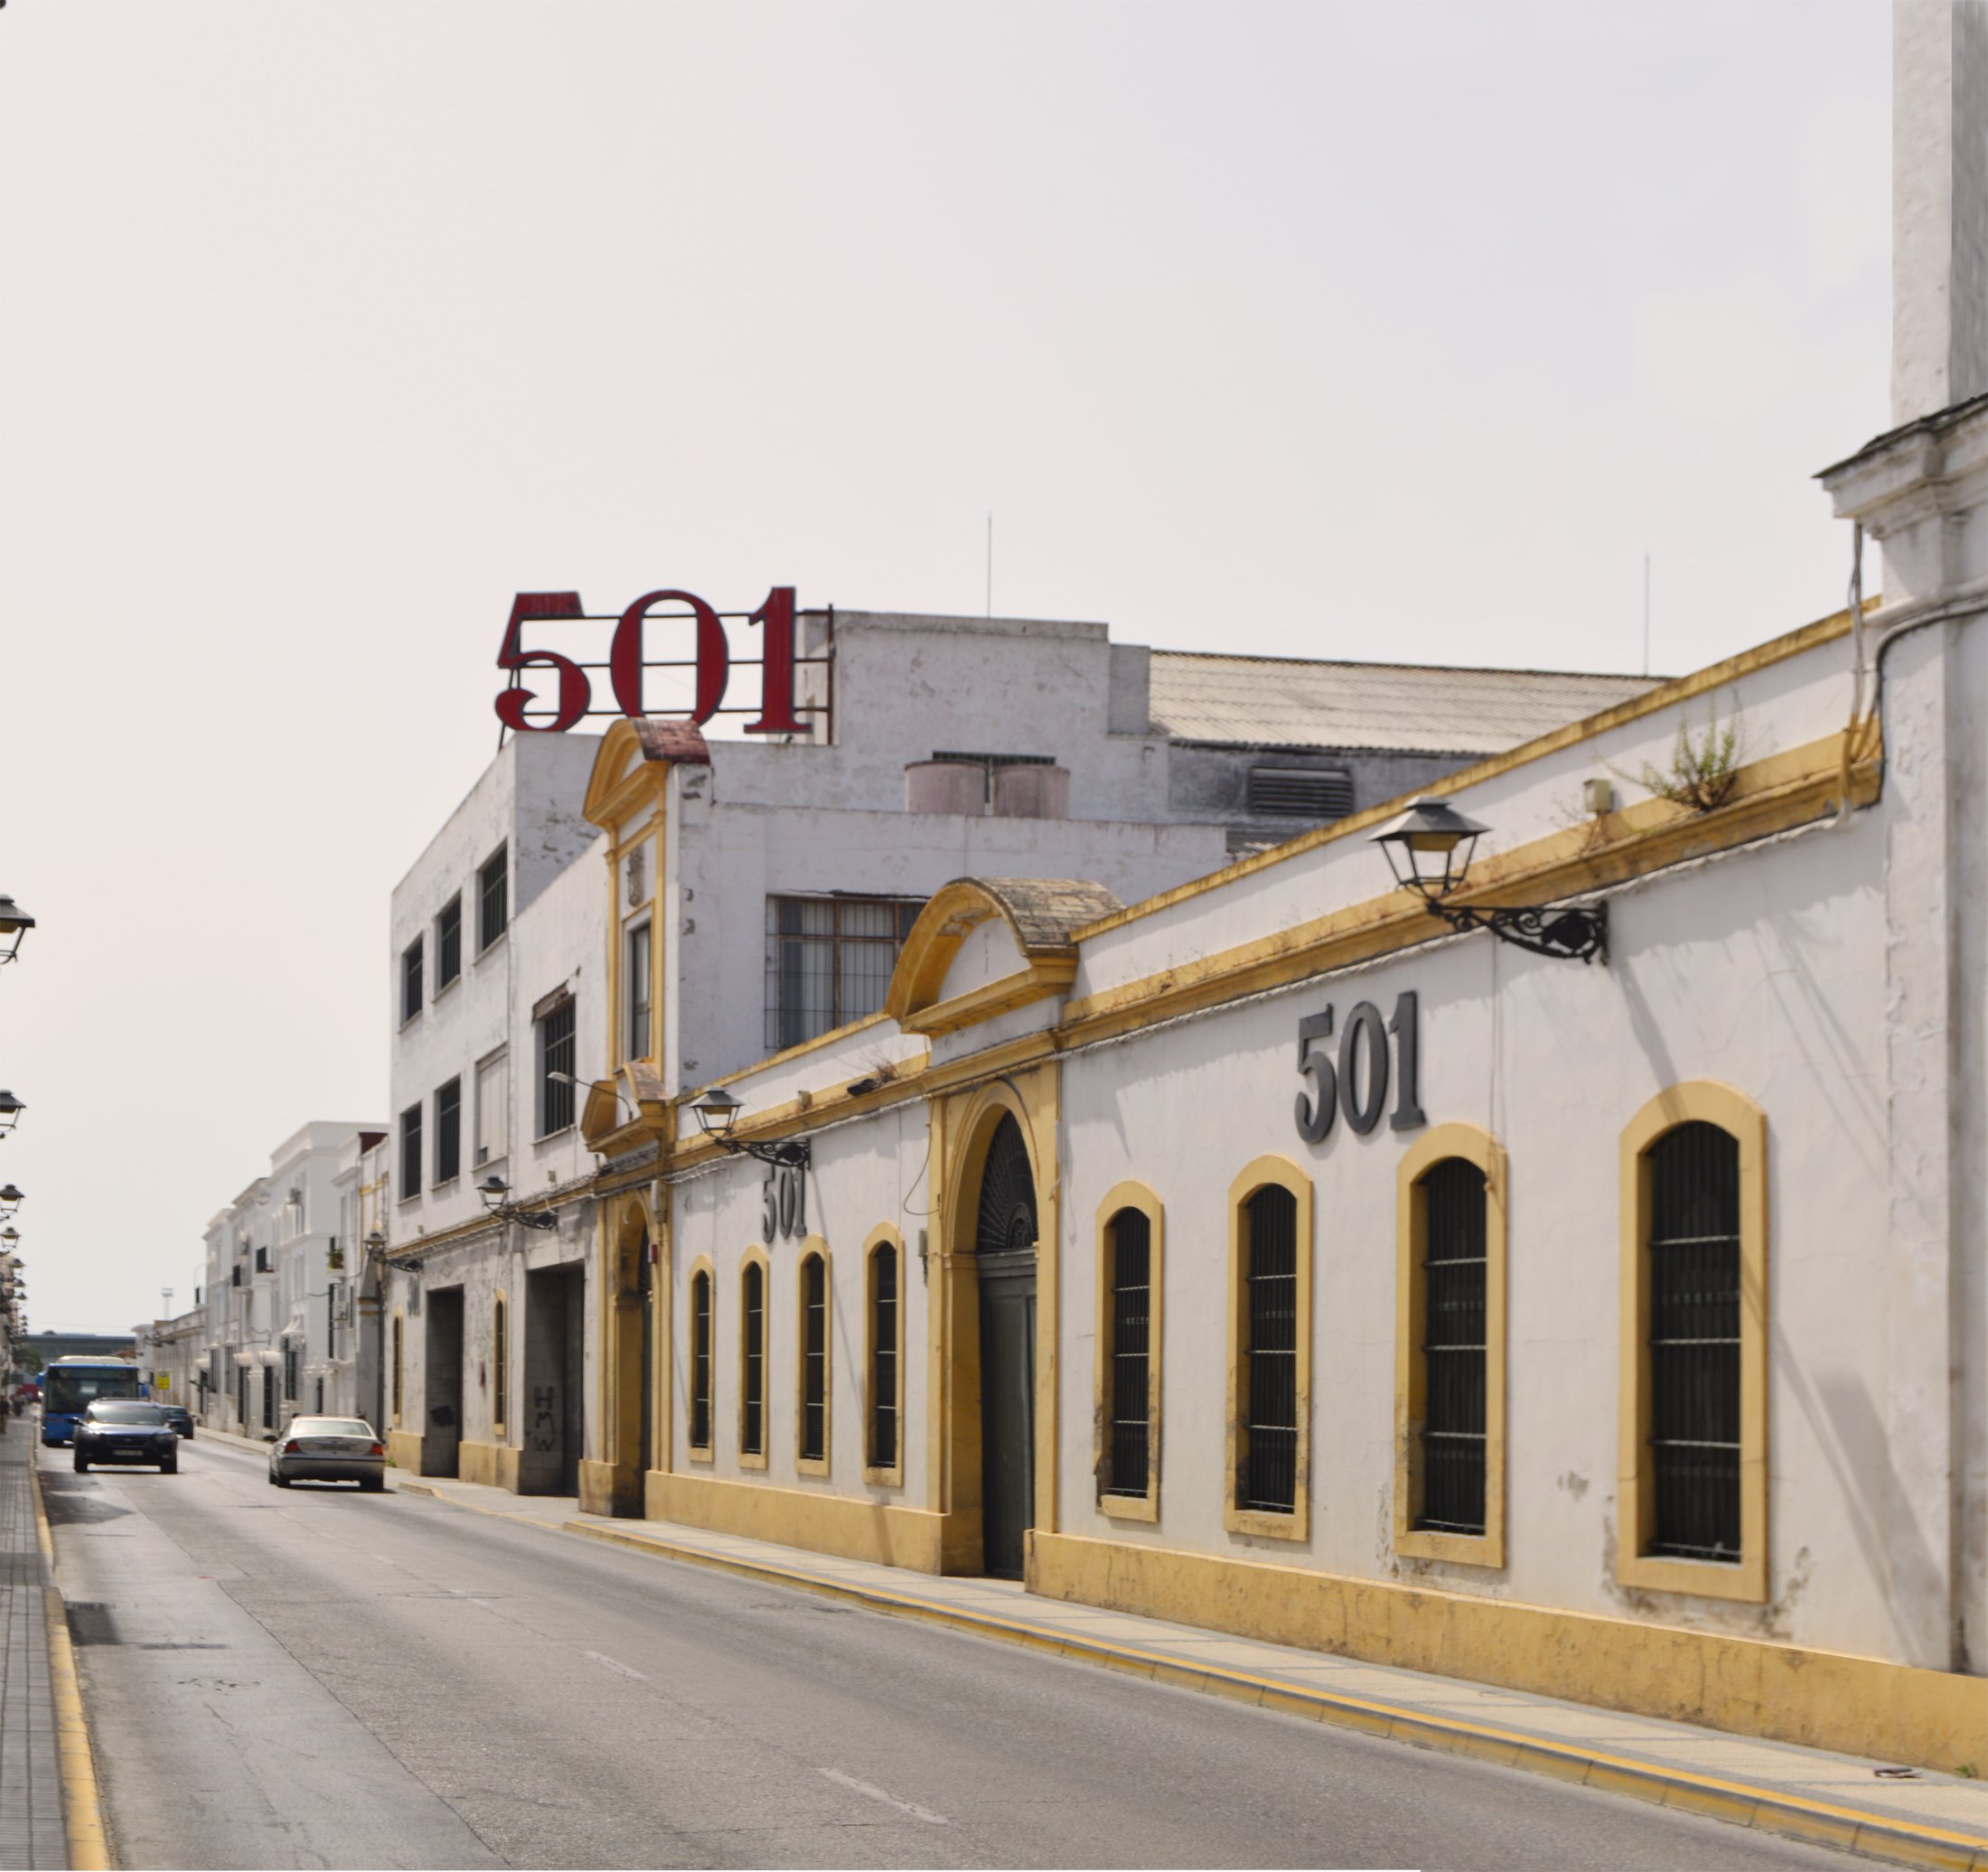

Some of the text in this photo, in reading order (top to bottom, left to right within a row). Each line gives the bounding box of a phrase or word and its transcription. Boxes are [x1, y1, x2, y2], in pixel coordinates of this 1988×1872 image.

[495, 586, 811, 733] 501
[1295, 989, 1426, 1144] 501
[763, 1164, 807, 1243] 501
